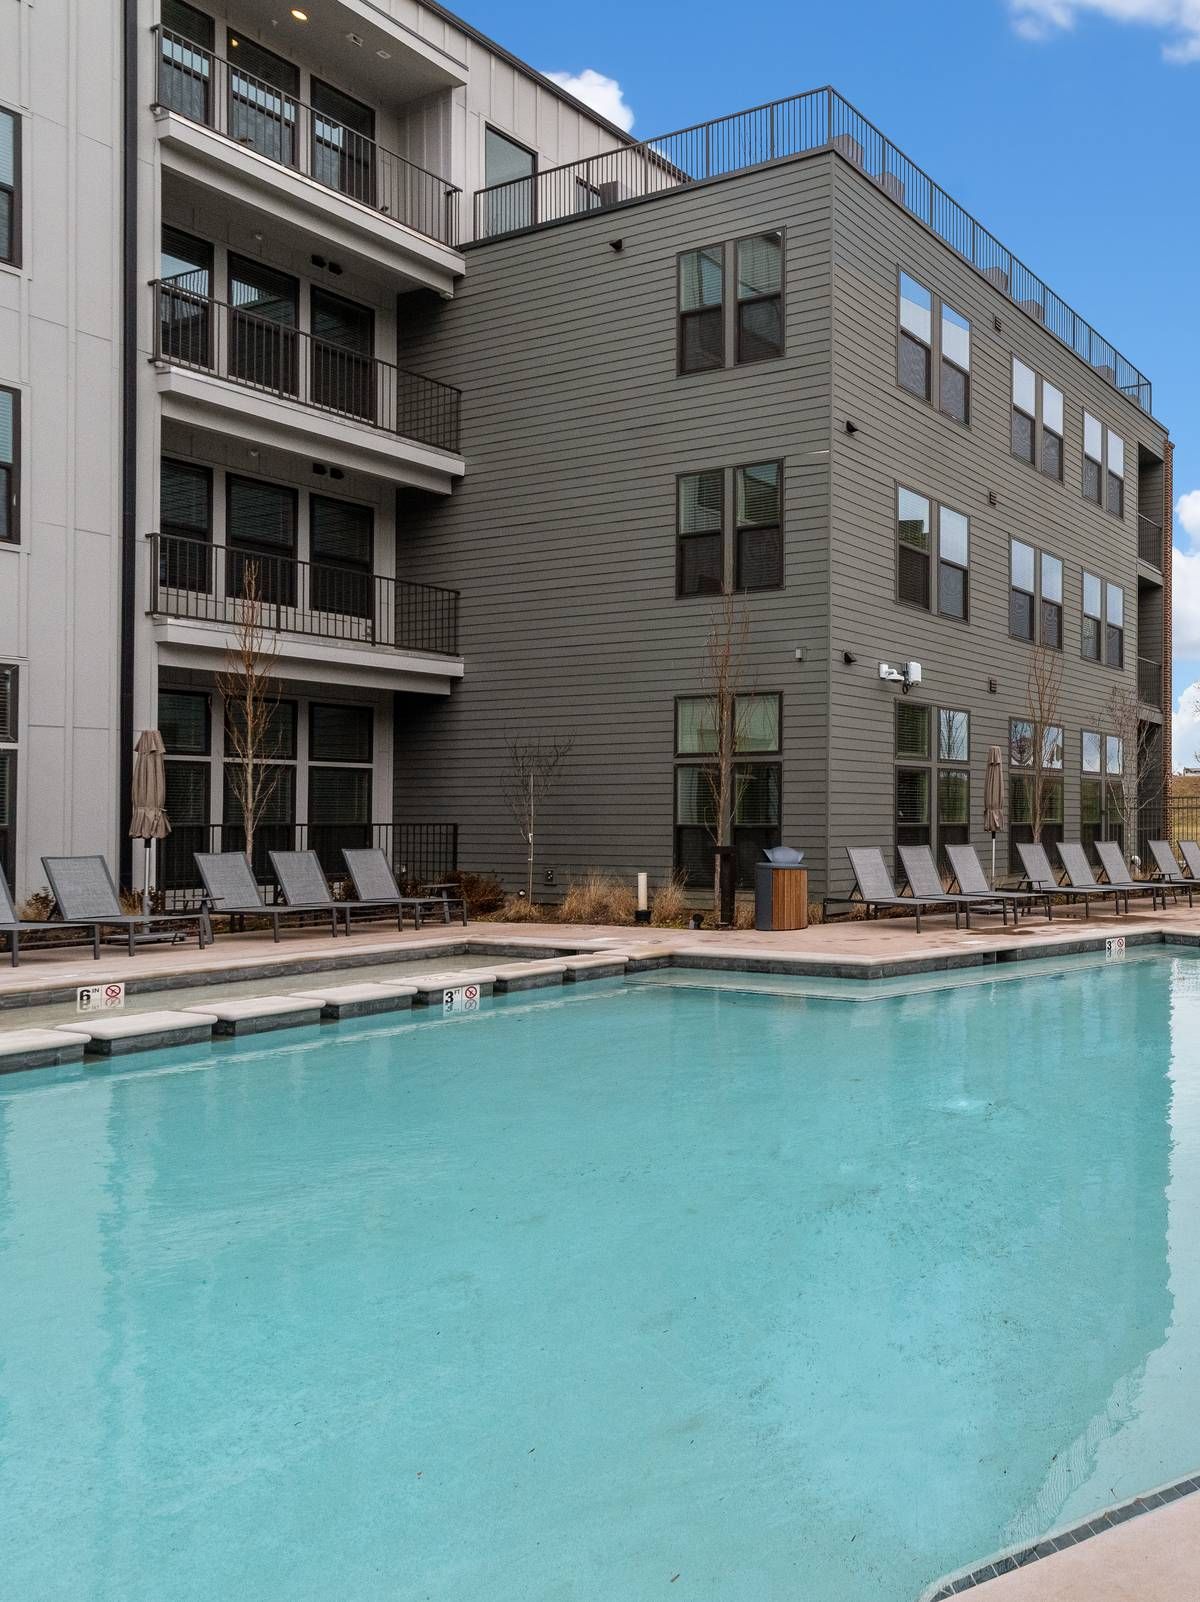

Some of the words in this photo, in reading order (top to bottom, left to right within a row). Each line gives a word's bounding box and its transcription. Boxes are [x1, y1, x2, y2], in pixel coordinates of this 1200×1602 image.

[1107, 940, 1112, 950] 3
[80, 989, 91, 1001] 6
[445, 991, 454, 1004] 3
